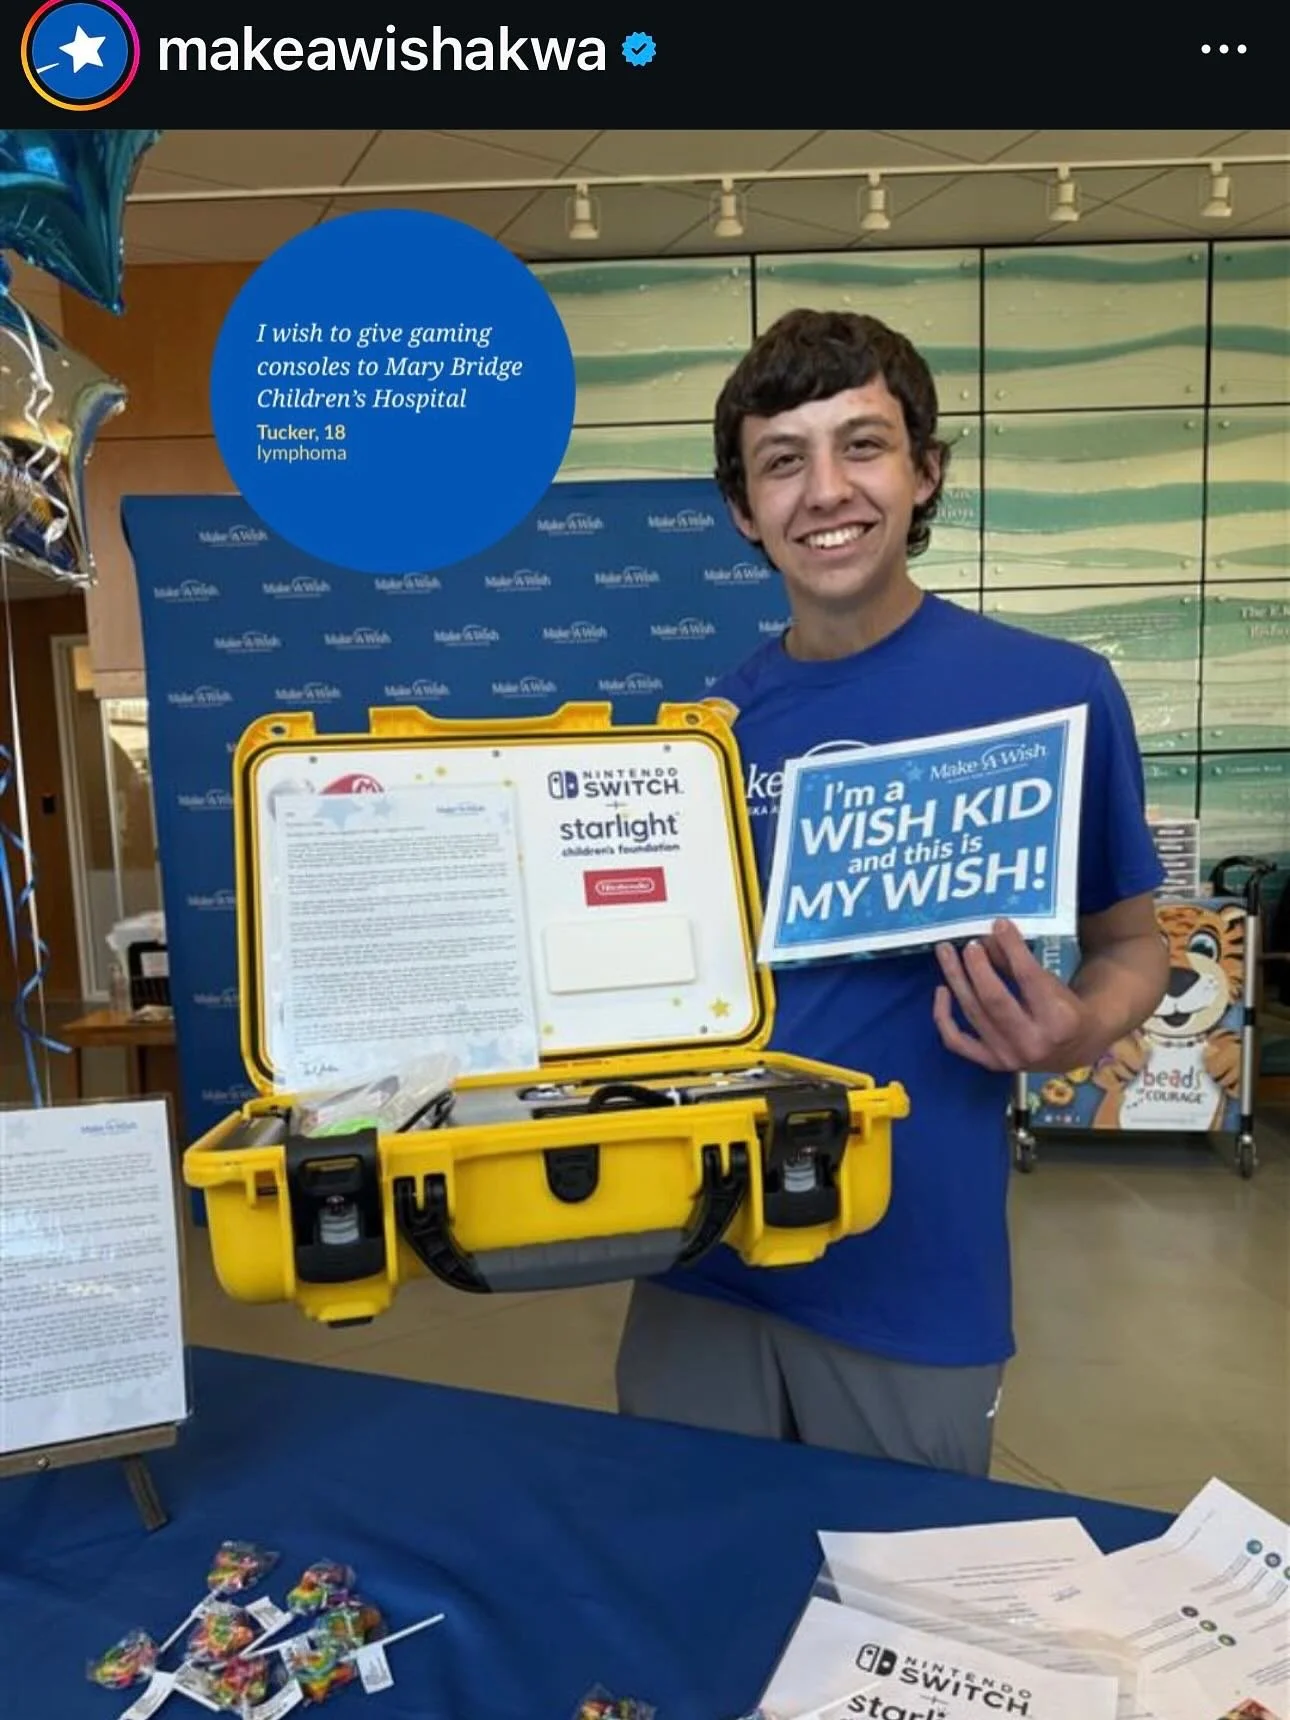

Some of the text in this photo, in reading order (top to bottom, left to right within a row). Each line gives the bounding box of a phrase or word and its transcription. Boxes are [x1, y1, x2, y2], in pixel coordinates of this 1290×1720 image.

[583, 767, 678, 779] NINTENDO
[584, 779, 679, 797] SWITCH
[885, 780, 904, 801] a
[560, 811, 679, 843] starlight
[801, 778, 1053, 856] WISH KID
[618, 843, 681, 855] foundation
[848, 833, 983, 875] and this is
[786, 846, 1047, 925] MY WISH!
[900, 1667, 1029, 1716] SWITCH
[904, 1656, 1032, 1699] NINTENDO
